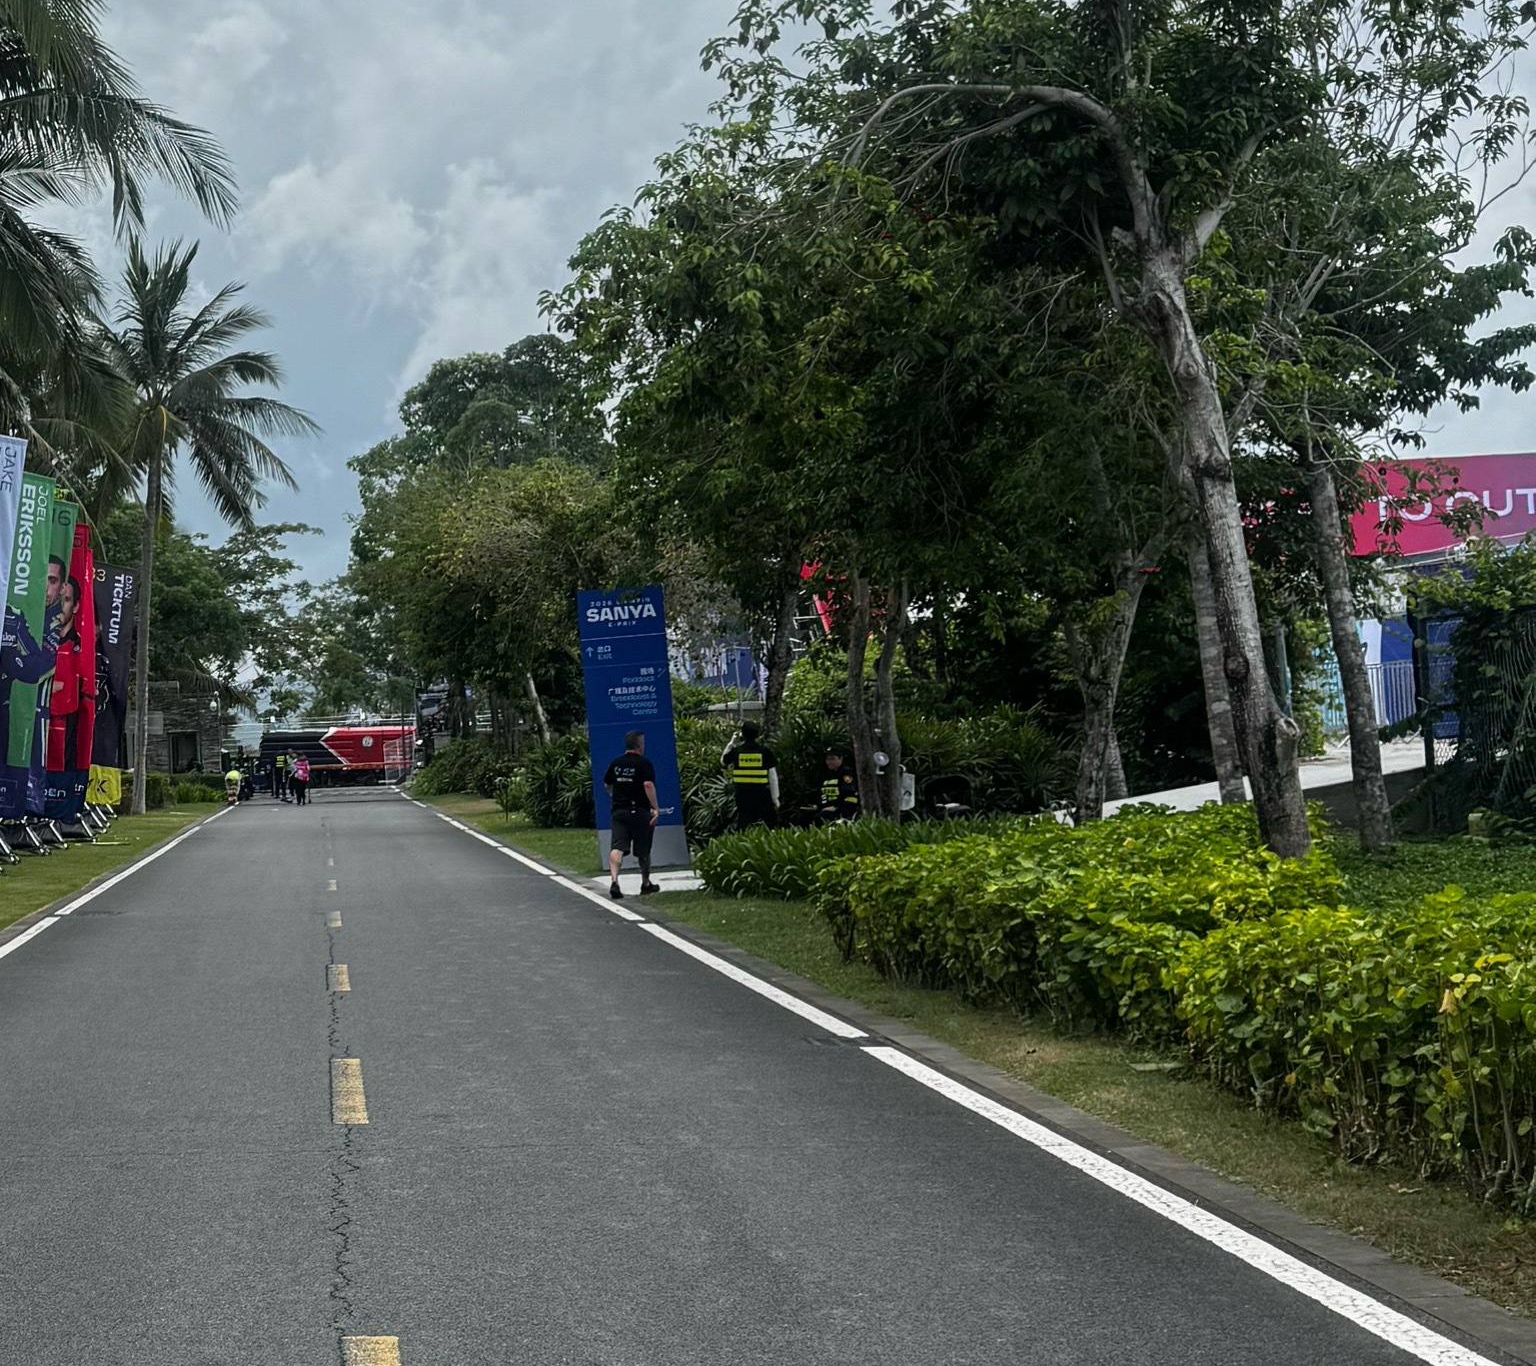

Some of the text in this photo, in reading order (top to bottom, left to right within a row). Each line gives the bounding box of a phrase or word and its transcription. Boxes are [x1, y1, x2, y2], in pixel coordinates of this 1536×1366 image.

[0, 446, 17, 493] JAKE
[37, 486, 48, 524] JOEL
[14, 484, 36, 596] ERIKSSON
[125, 575, 133, 598] DAN
[109, 574, 124, 644] TICKTUM
[586, 603, 657, 623] SANYA
